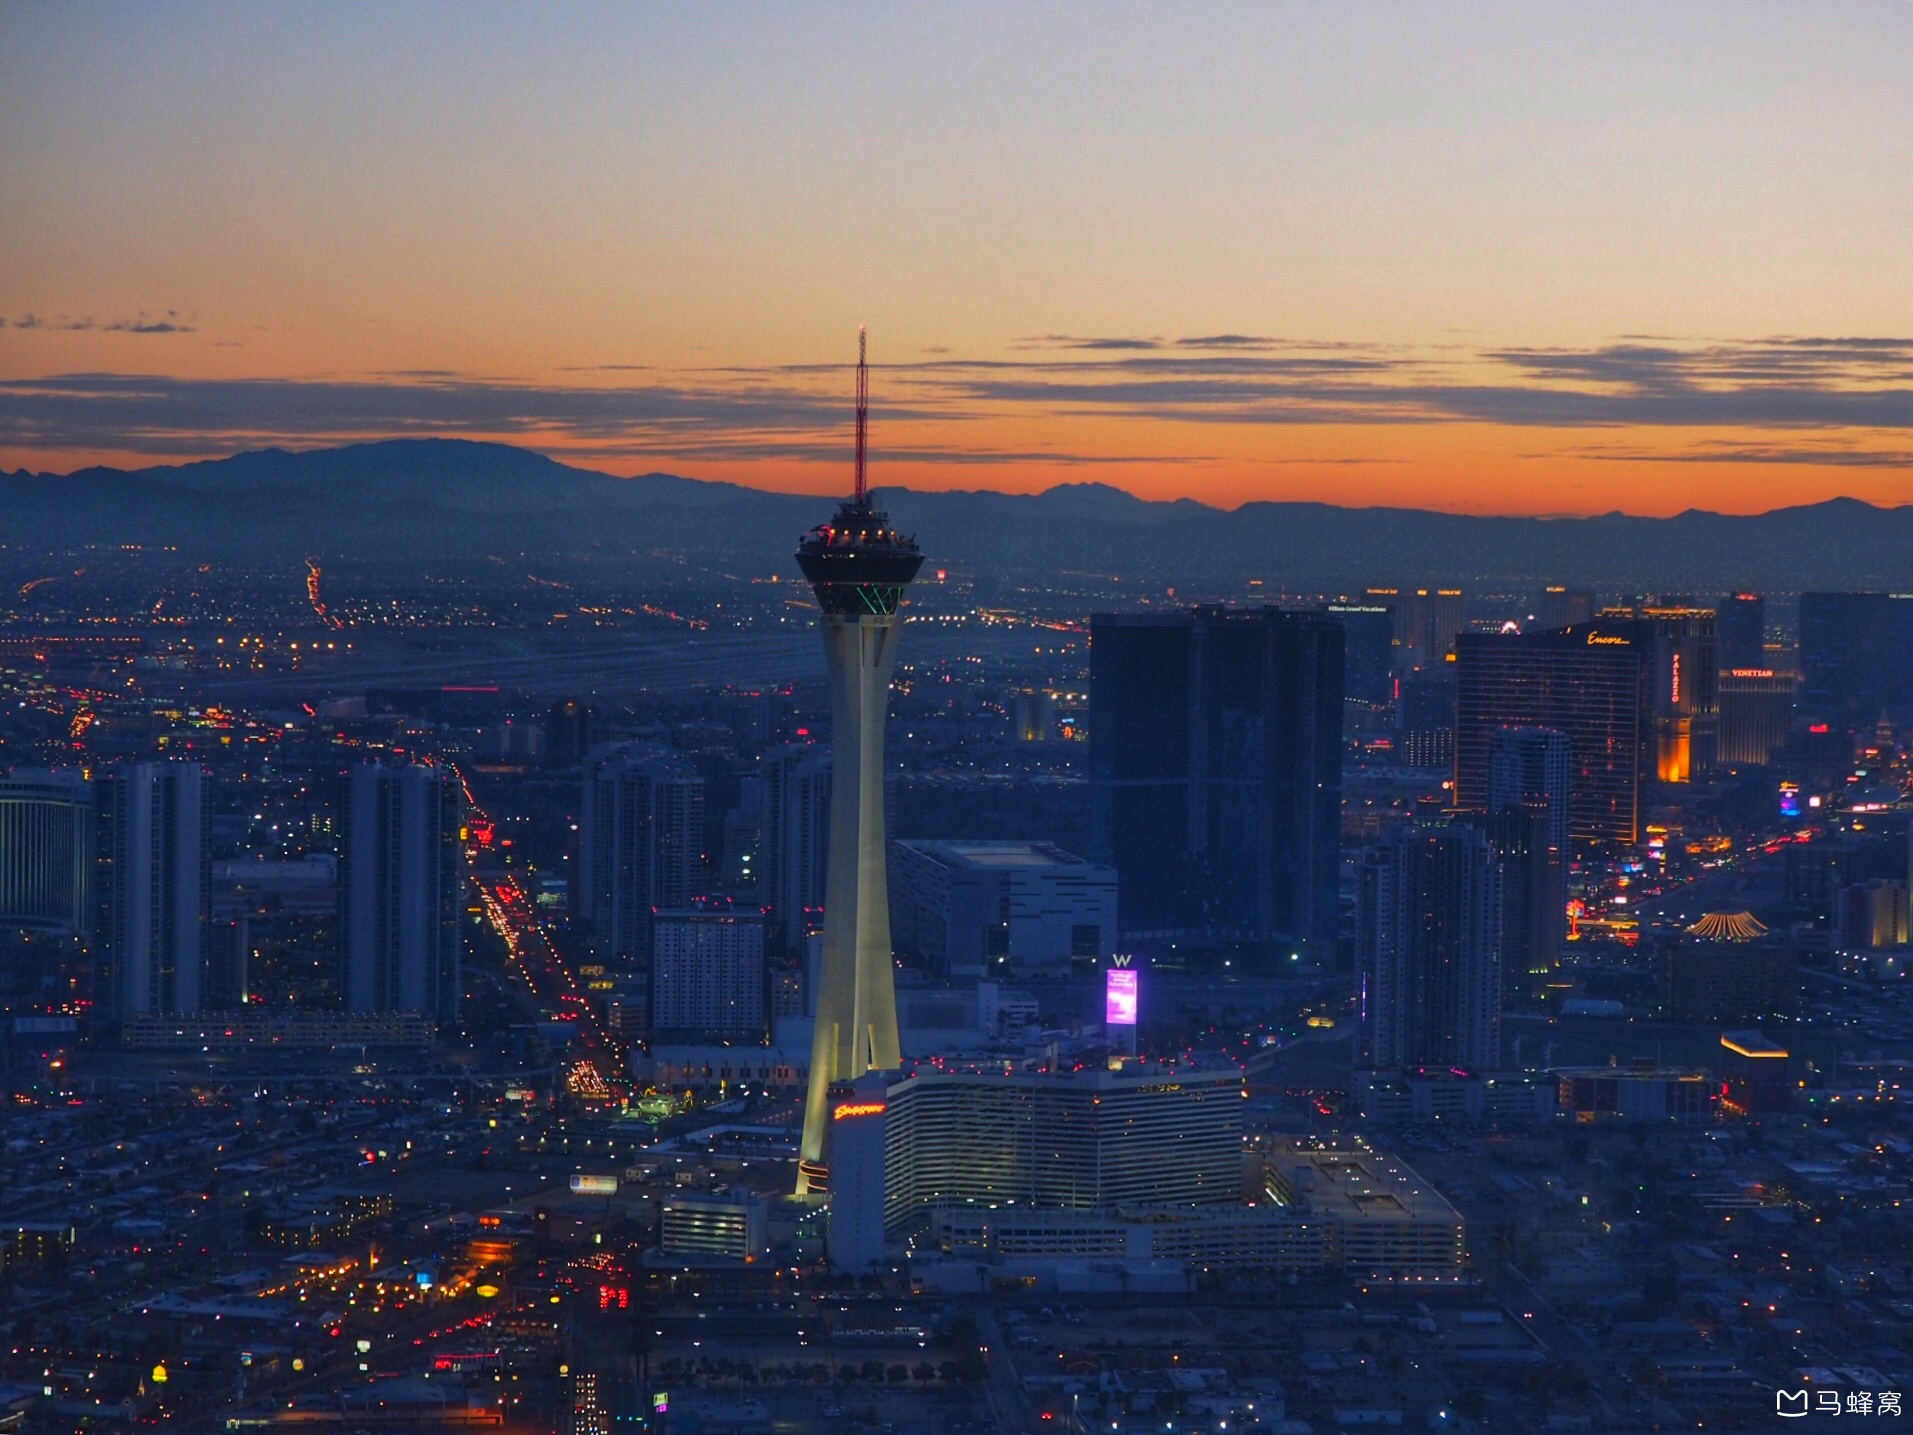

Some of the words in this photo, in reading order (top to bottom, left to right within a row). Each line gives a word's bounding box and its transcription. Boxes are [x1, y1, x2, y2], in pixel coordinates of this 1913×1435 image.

[1587, 630, 1630, 645] Encore
[1672, 654, 1680, 702] PALAZZO
[1732, 669, 1773, 678] VENETIAN
[1112, 953, 1132, 968] W
